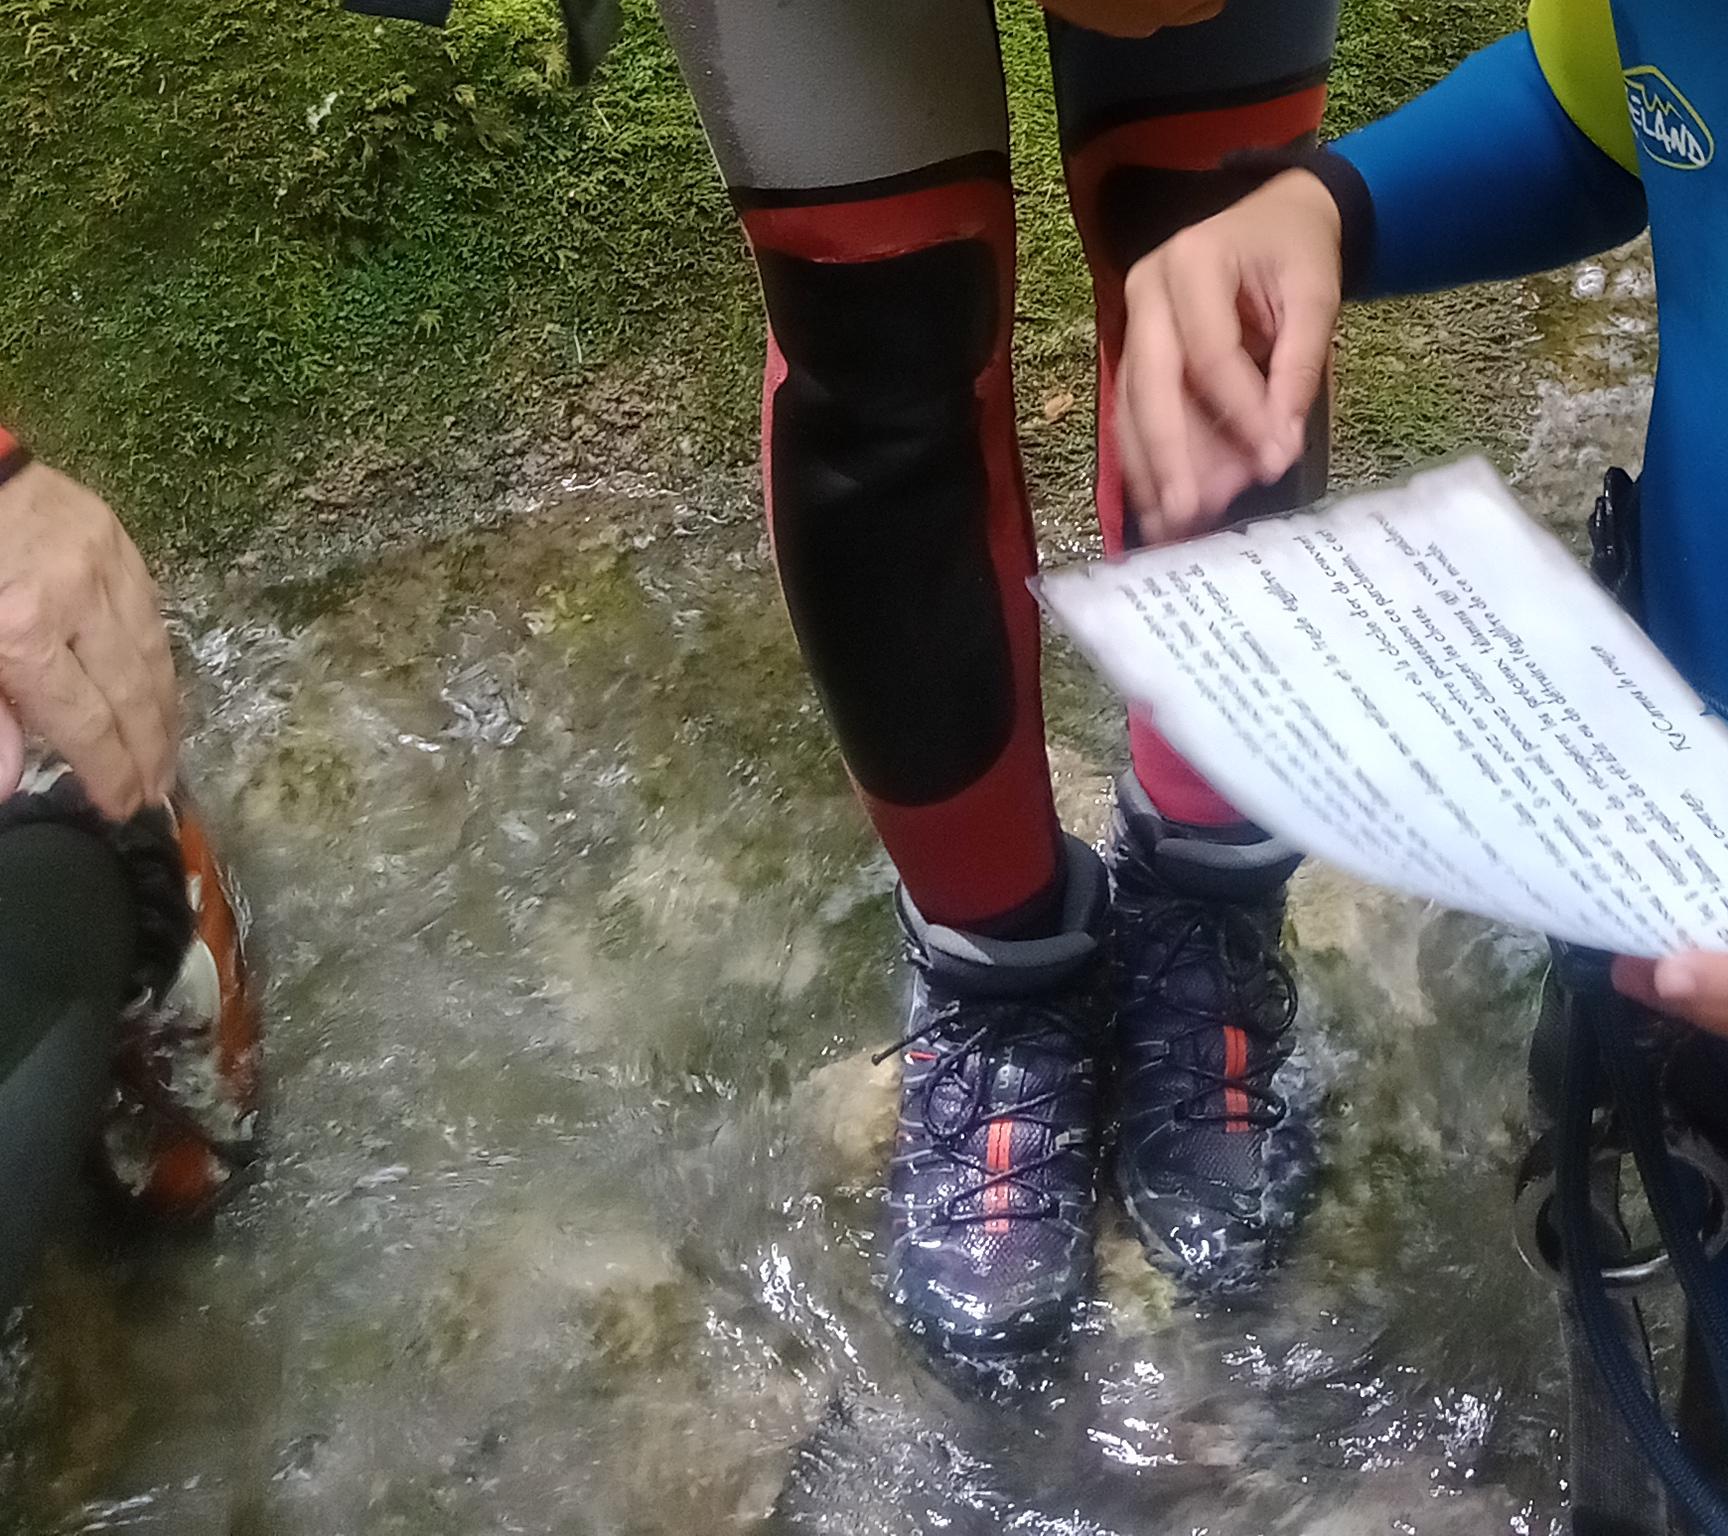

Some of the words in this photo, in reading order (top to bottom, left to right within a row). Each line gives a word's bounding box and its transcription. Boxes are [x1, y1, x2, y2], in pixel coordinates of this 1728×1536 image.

[1624, 86, 1706, 166] ELAND
[1292, 535, 1336, 577] couvent
[1330, 580, 1350, 594] du
[1455, 578, 1473, 593] ce
[1467, 595, 1487, 609] de
[1383, 608, 1401, 623] ce
[1364, 621, 1400, 656] cloche
[1397, 624, 1453, 679] possession
[1441, 644, 1461, 662] les
[1493, 657, 1548, 709] précieux
